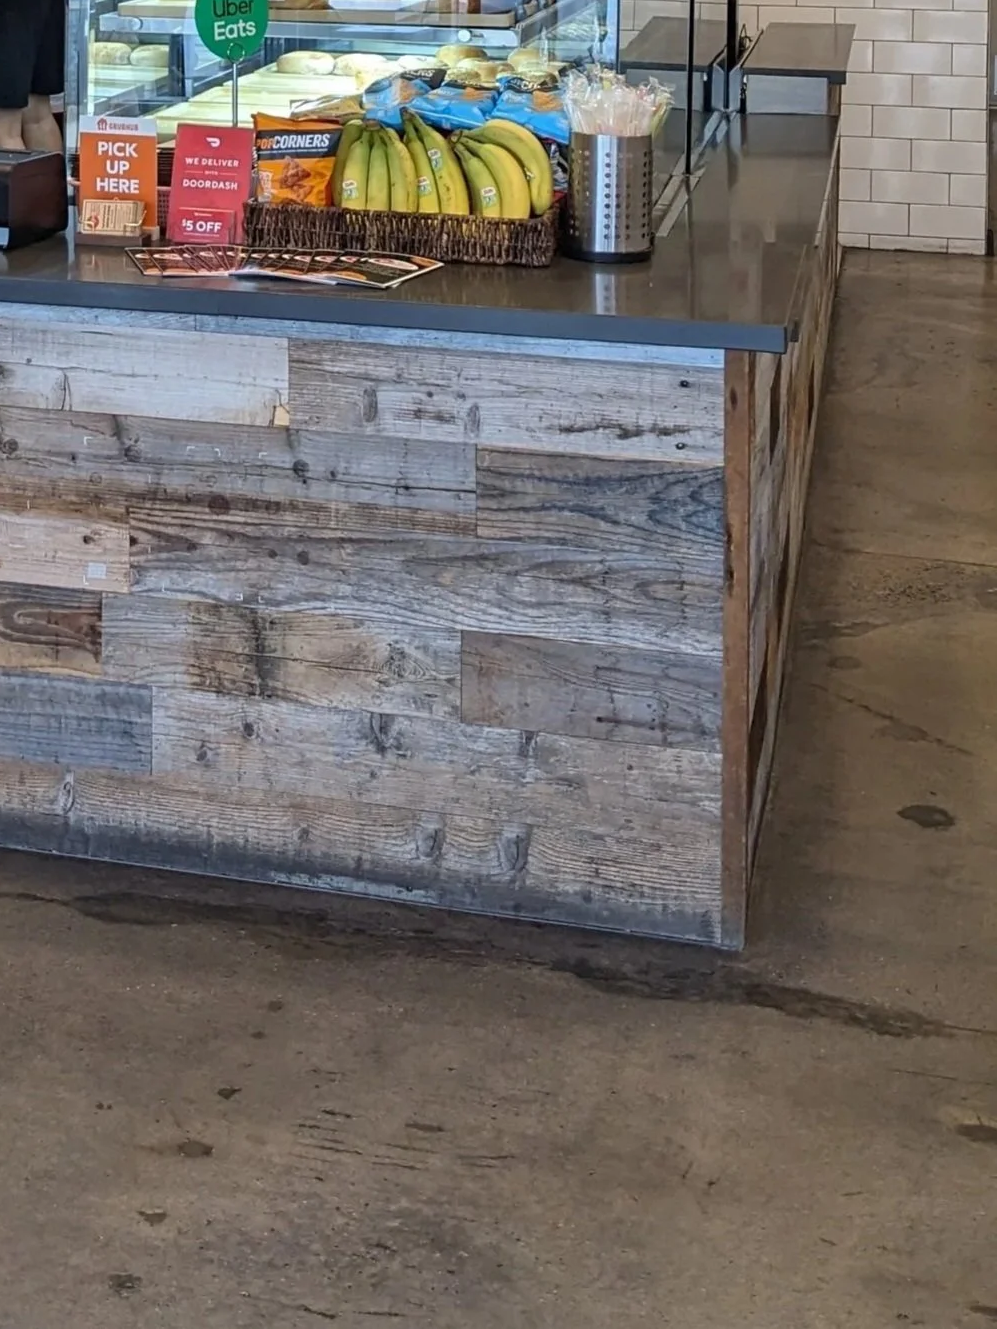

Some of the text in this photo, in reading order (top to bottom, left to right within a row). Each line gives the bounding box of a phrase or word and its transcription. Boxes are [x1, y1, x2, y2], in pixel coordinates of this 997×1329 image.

[213, 0, 254, 18] Uber
[214, 19, 256, 41] Eats
[97, 140, 138, 158] PICK
[106, 159, 130, 175] UP
[185, 157, 239, 168] WE DELIVER
[96, 177, 140, 194] HERE
[182, 178, 238, 190] DOORDASH
[182, 218, 222, 233] $5 OFF
